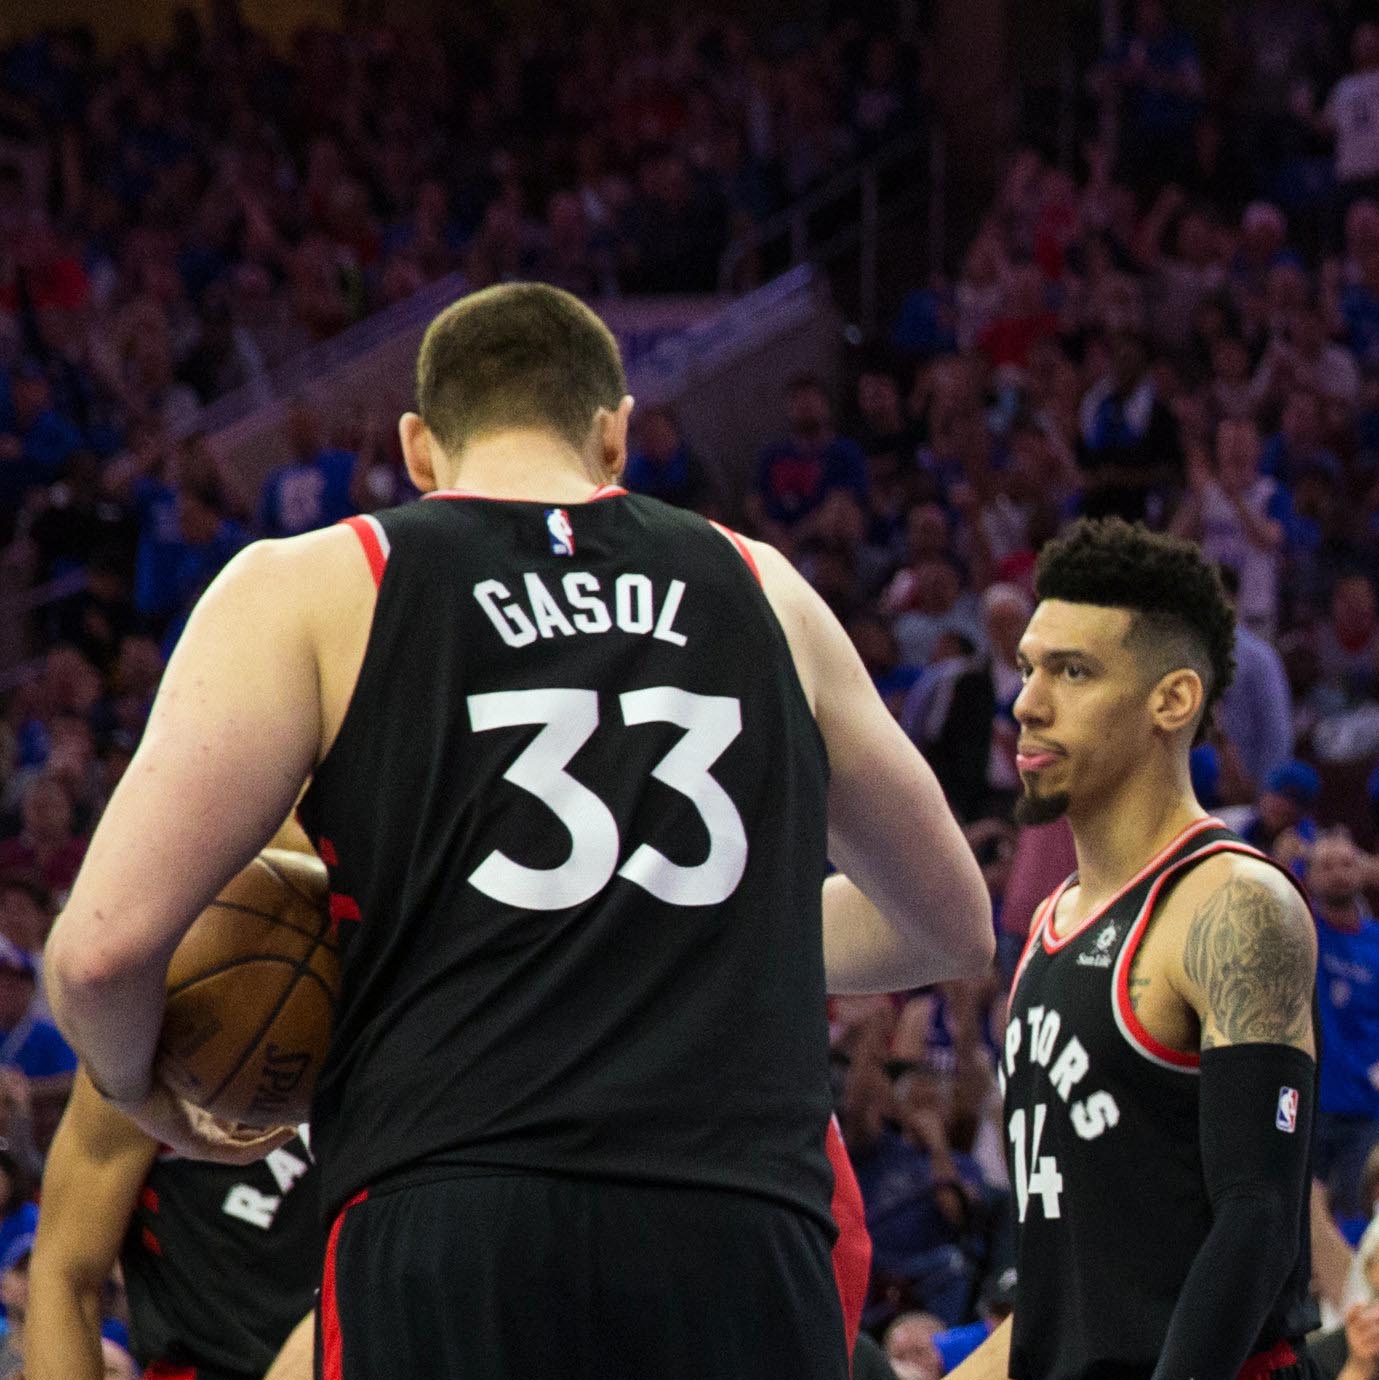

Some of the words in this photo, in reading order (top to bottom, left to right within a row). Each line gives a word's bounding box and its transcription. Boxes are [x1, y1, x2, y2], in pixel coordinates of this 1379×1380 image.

[473, 571, 689, 649] GASOL
[466, 685, 749, 911] 33
[998, 1005, 1121, 1141] PTORS
[222, 1122, 317, 1231] RA
[1008, 1103, 1064, 1224] 14
